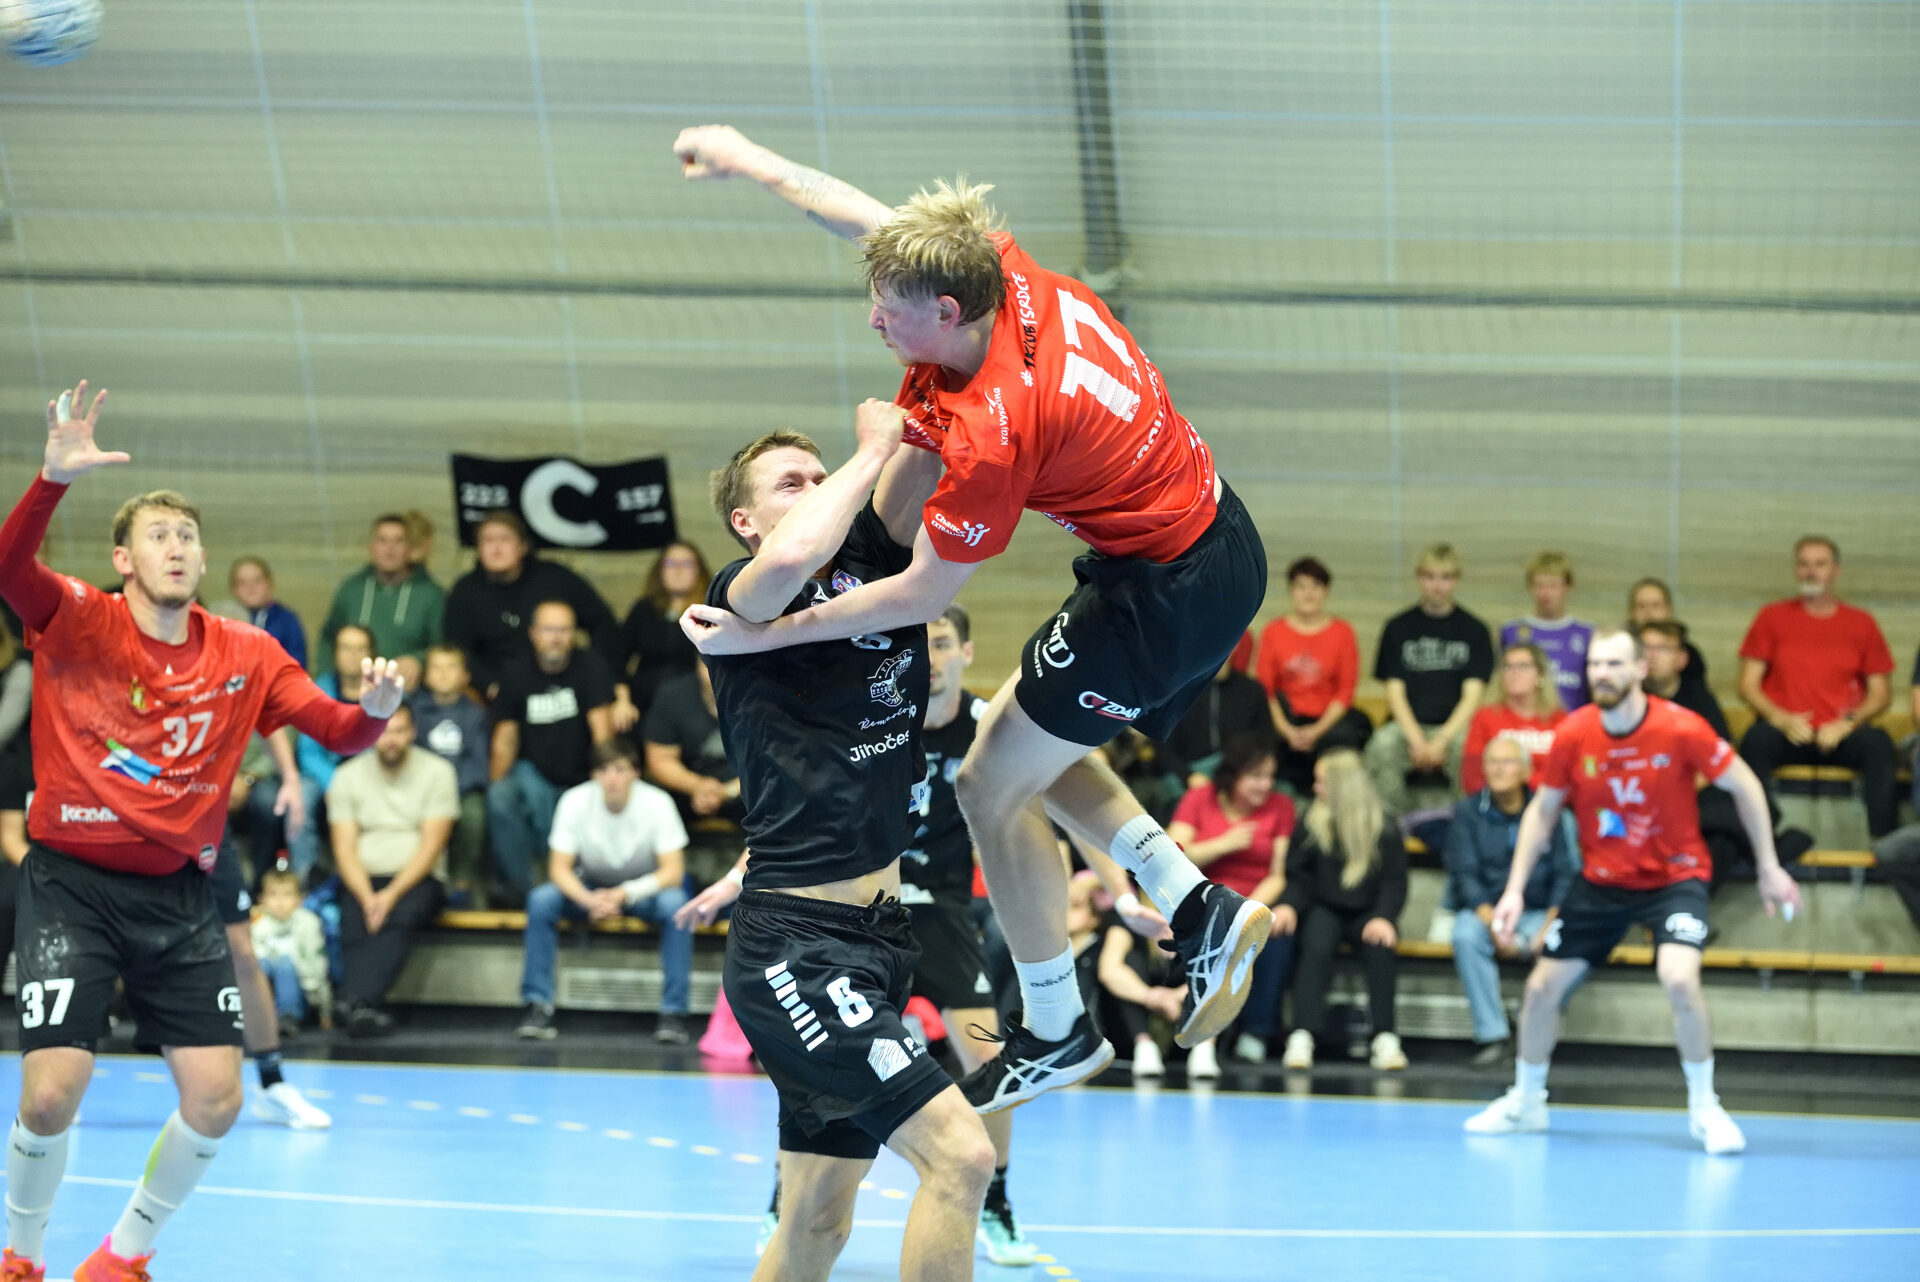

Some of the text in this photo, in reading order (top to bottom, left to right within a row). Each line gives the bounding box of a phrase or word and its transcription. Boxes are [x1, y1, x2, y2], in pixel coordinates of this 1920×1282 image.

[1056, 287, 1143, 424] 17
[1001, 426, 1010, 446] Kraj
[520, 459, 608, 547] C
[161, 711, 213, 757] 37
[22, 977, 75, 1029] 37
